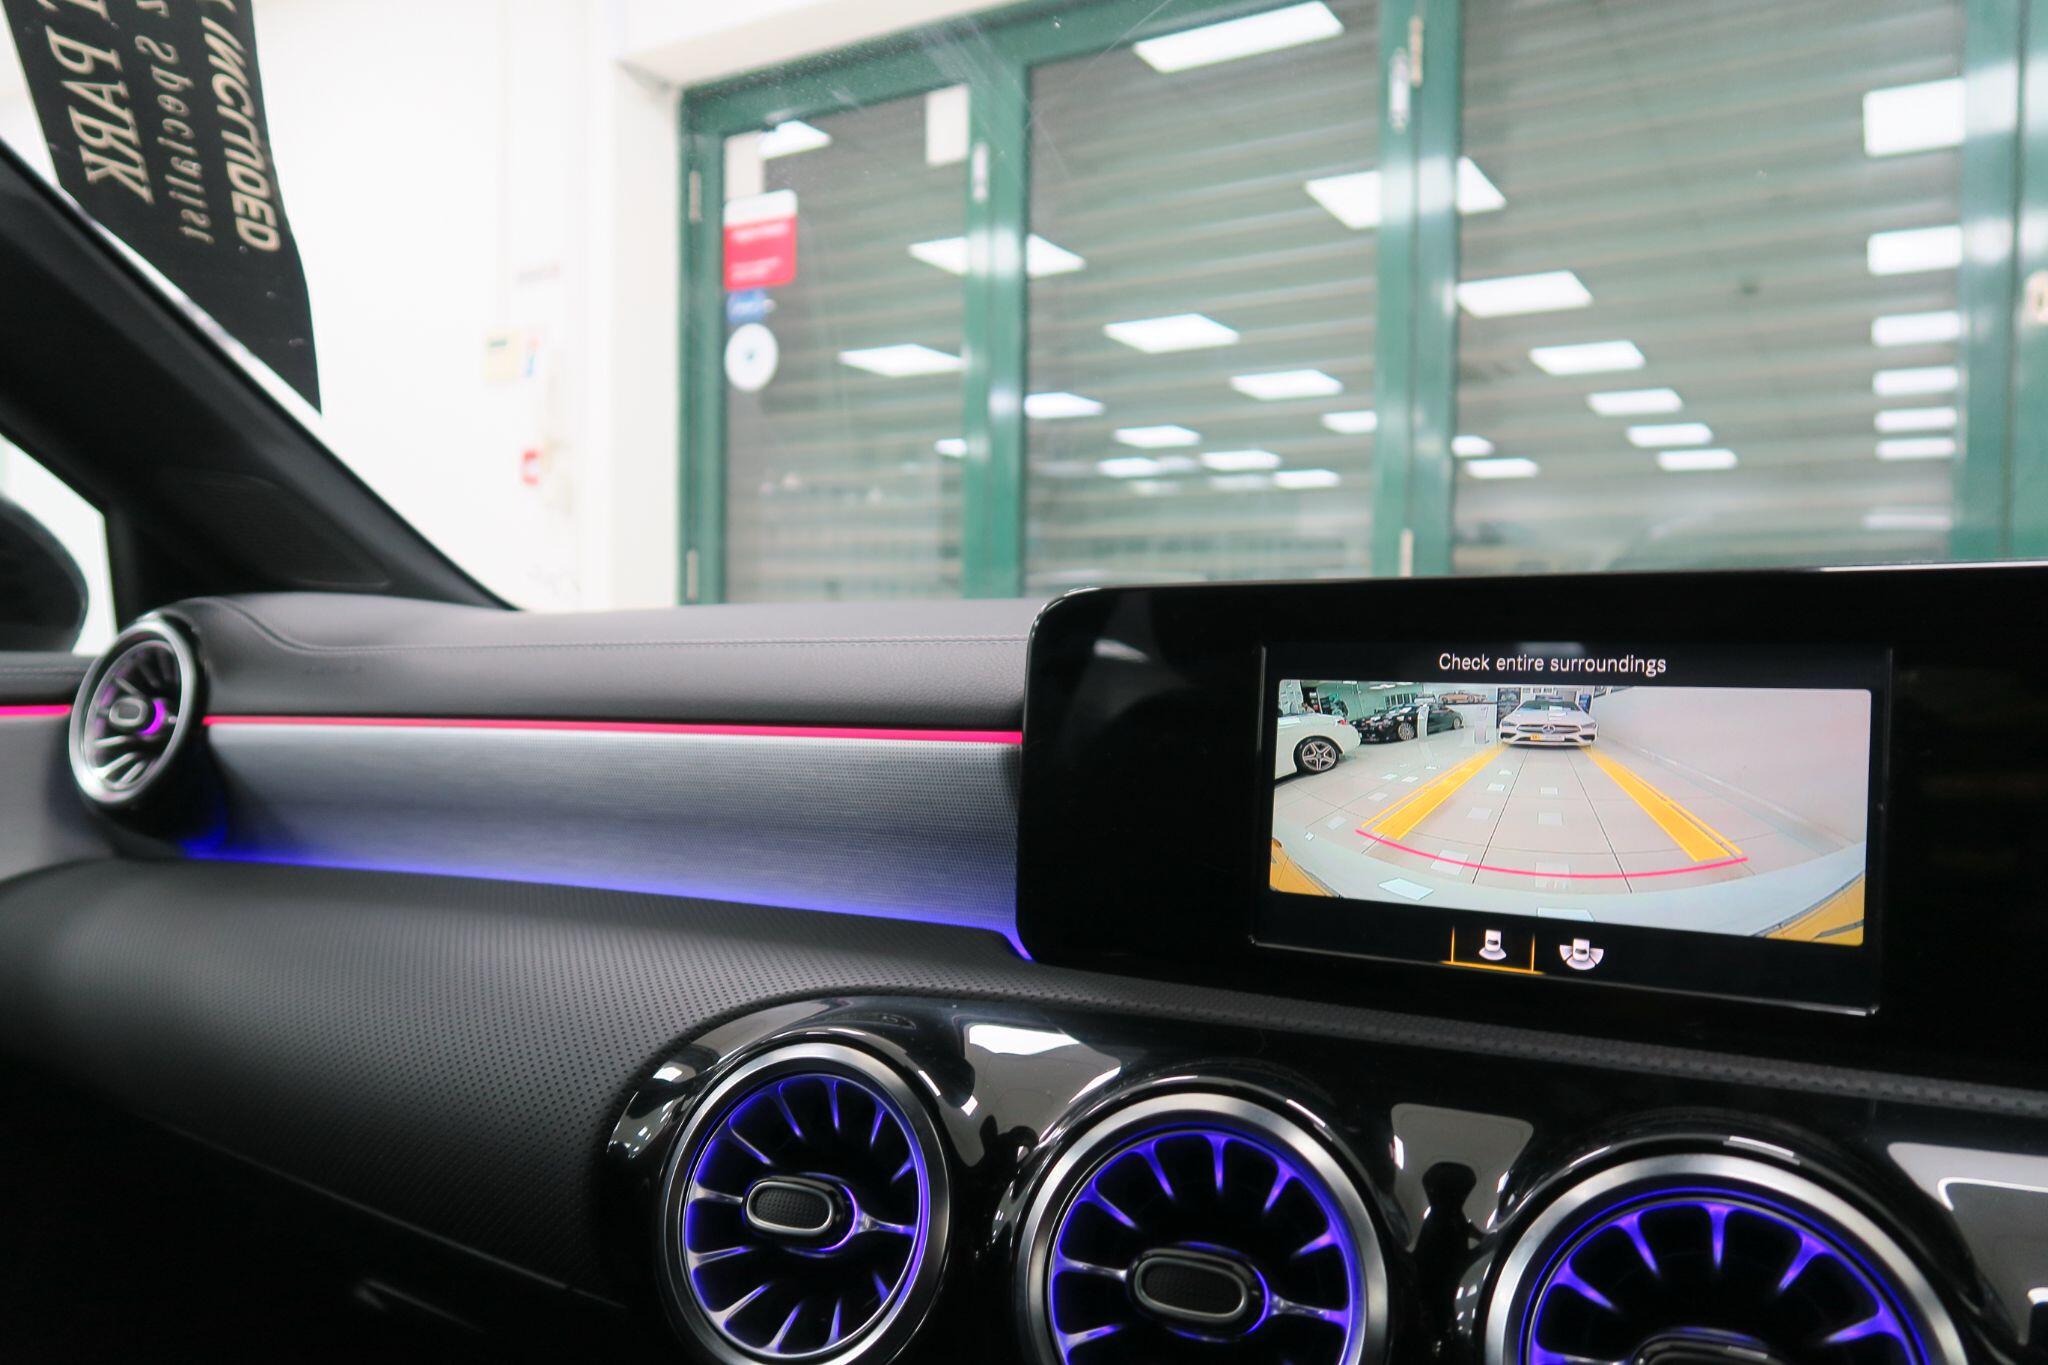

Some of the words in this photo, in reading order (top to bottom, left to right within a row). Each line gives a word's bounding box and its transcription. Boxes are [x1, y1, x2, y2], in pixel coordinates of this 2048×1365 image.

[1439, 652, 1490, 671] Check
[1496, 654, 1544, 672] entire
[1550, 654, 1667, 678] surroundings
